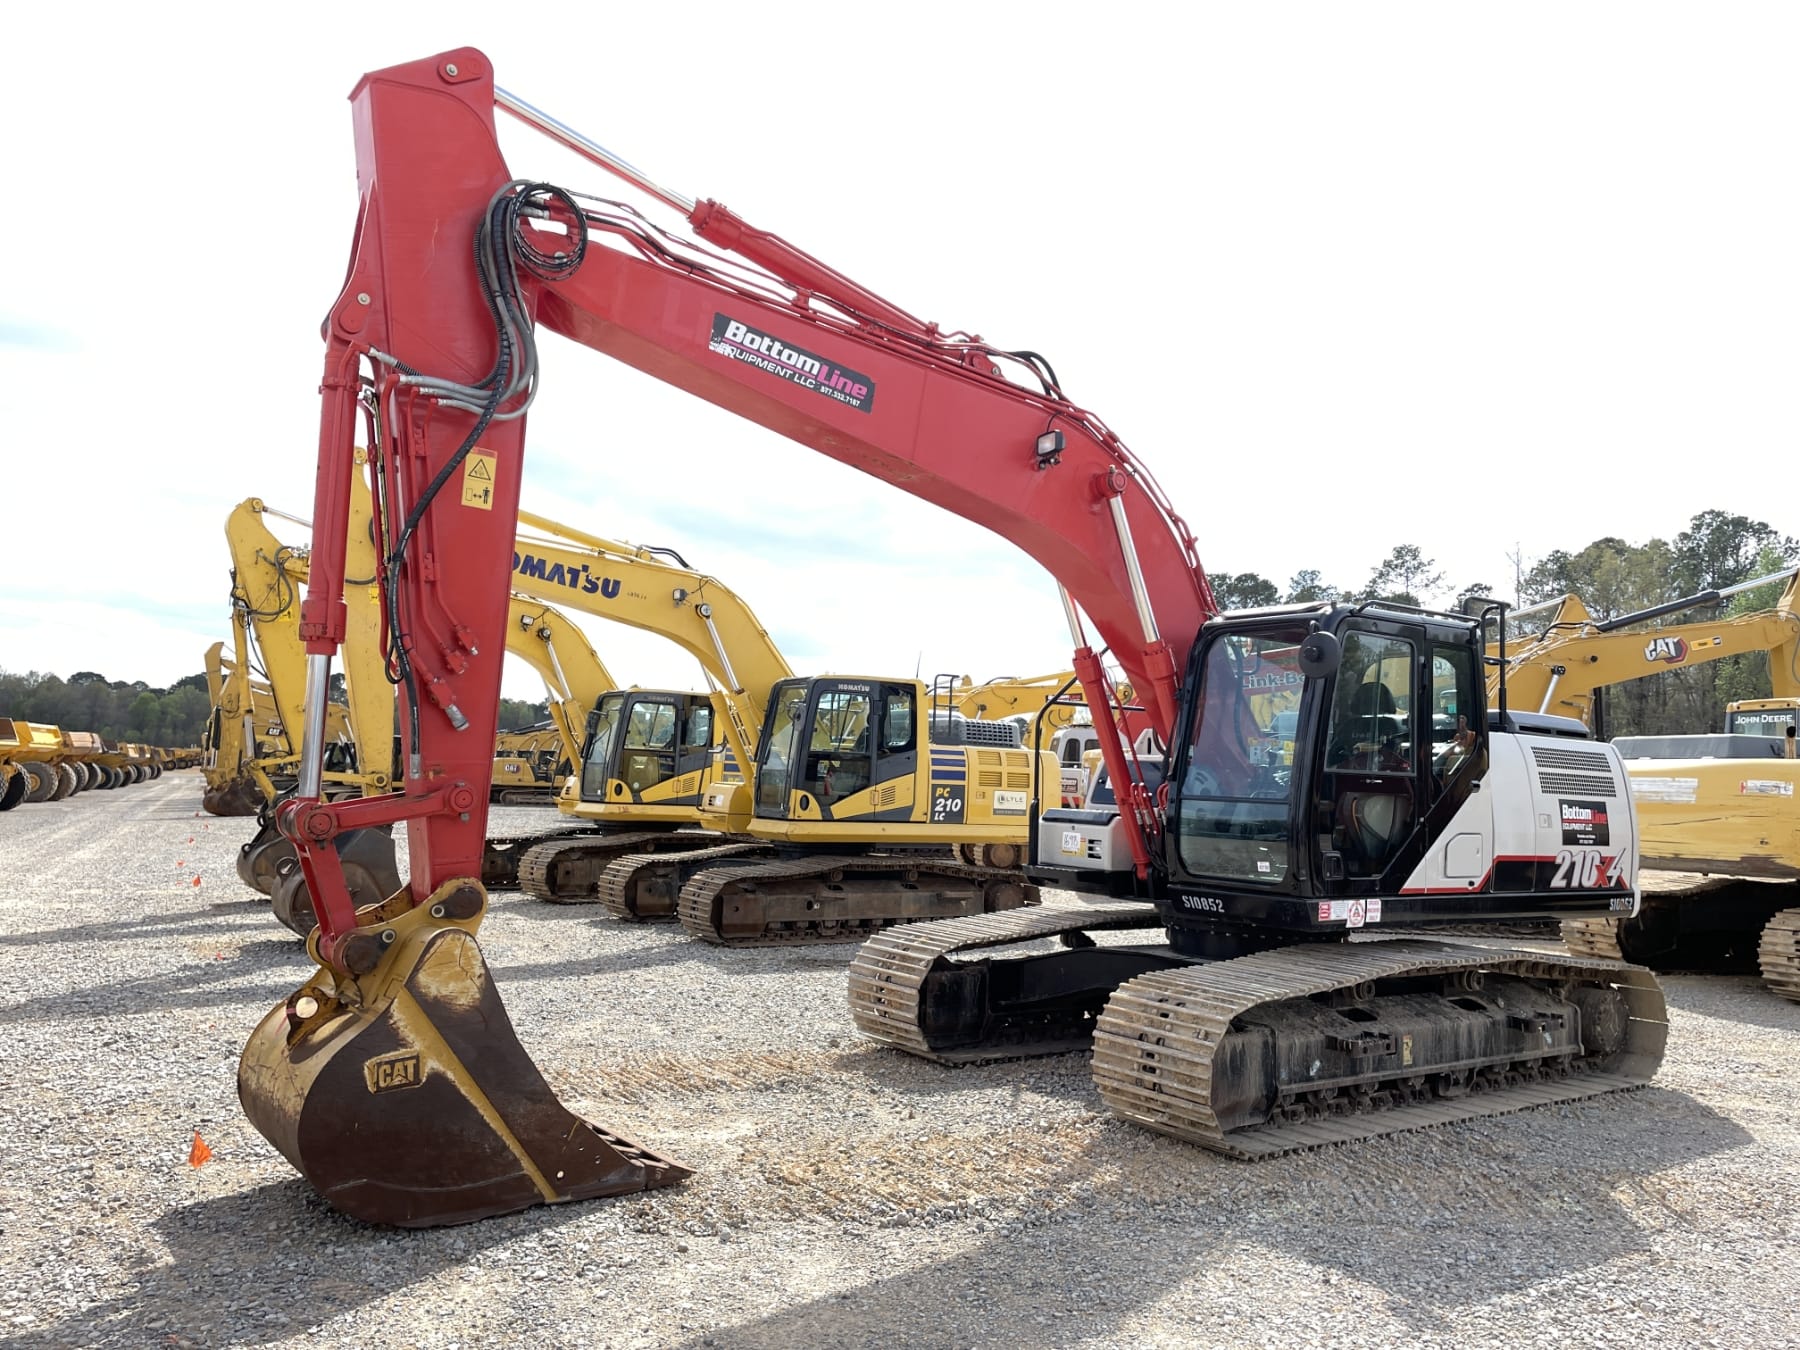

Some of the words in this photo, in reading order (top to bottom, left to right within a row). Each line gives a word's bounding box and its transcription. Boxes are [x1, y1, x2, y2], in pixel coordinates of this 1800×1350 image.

[794, 372, 816, 389] LLC
[1644, 637, 1680, 661] CAT
[838, 683, 871, 692] KOMATSU
[1735, 715, 1760, 724] JOHN
[1761, 714, 1793, 723] DEERE
[935, 787, 951, 798] PC
[934, 798, 962, 812] 210
[934, 812, 946, 821] LC
[378, 1059, 417, 1088] CAT
